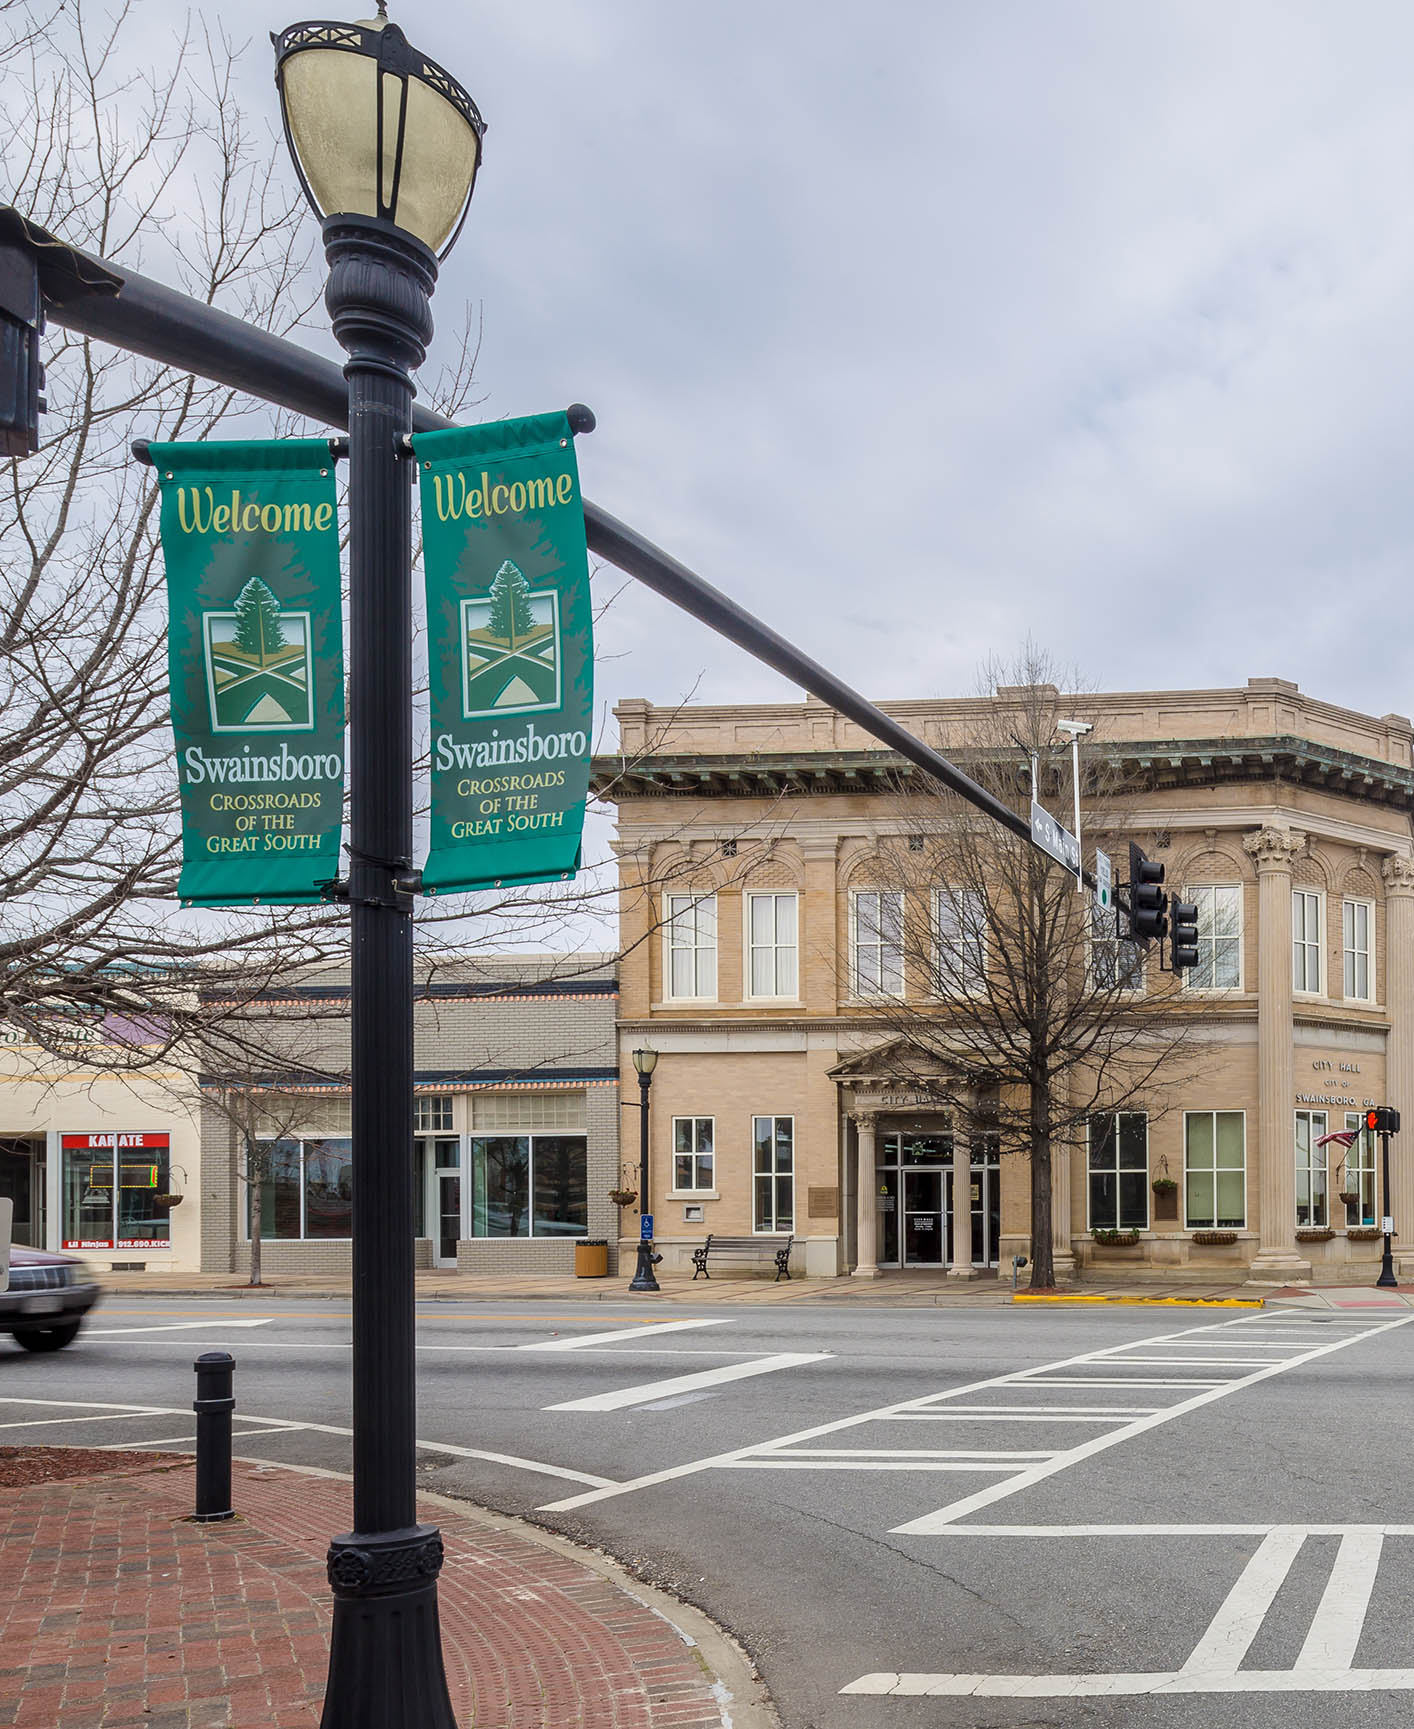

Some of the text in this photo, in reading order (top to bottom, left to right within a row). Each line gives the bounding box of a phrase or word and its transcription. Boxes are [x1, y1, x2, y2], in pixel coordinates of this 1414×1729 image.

[176, 486, 333, 534] Welcome
[433, 471, 573, 522] Welcome
[436, 723, 586, 772] Swainsboro
[185, 743, 342, 784] Swainsboro
[457, 770, 566, 797] CROSSROADS
[209, 792, 321, 811] CROSSROADS
[479, 794, 538, 814] OF THE
[235, 814, 295, 831] OF THE
[451, 811, 564, 839] GREAT SOUTH
[206, 833, 321, 853] GREAT SOUTH
[1045, 823, 1051, 842] S
[1052, 829, 1069, 860] Main
[1312, 1060, 1361, 1073] CITY HALL
